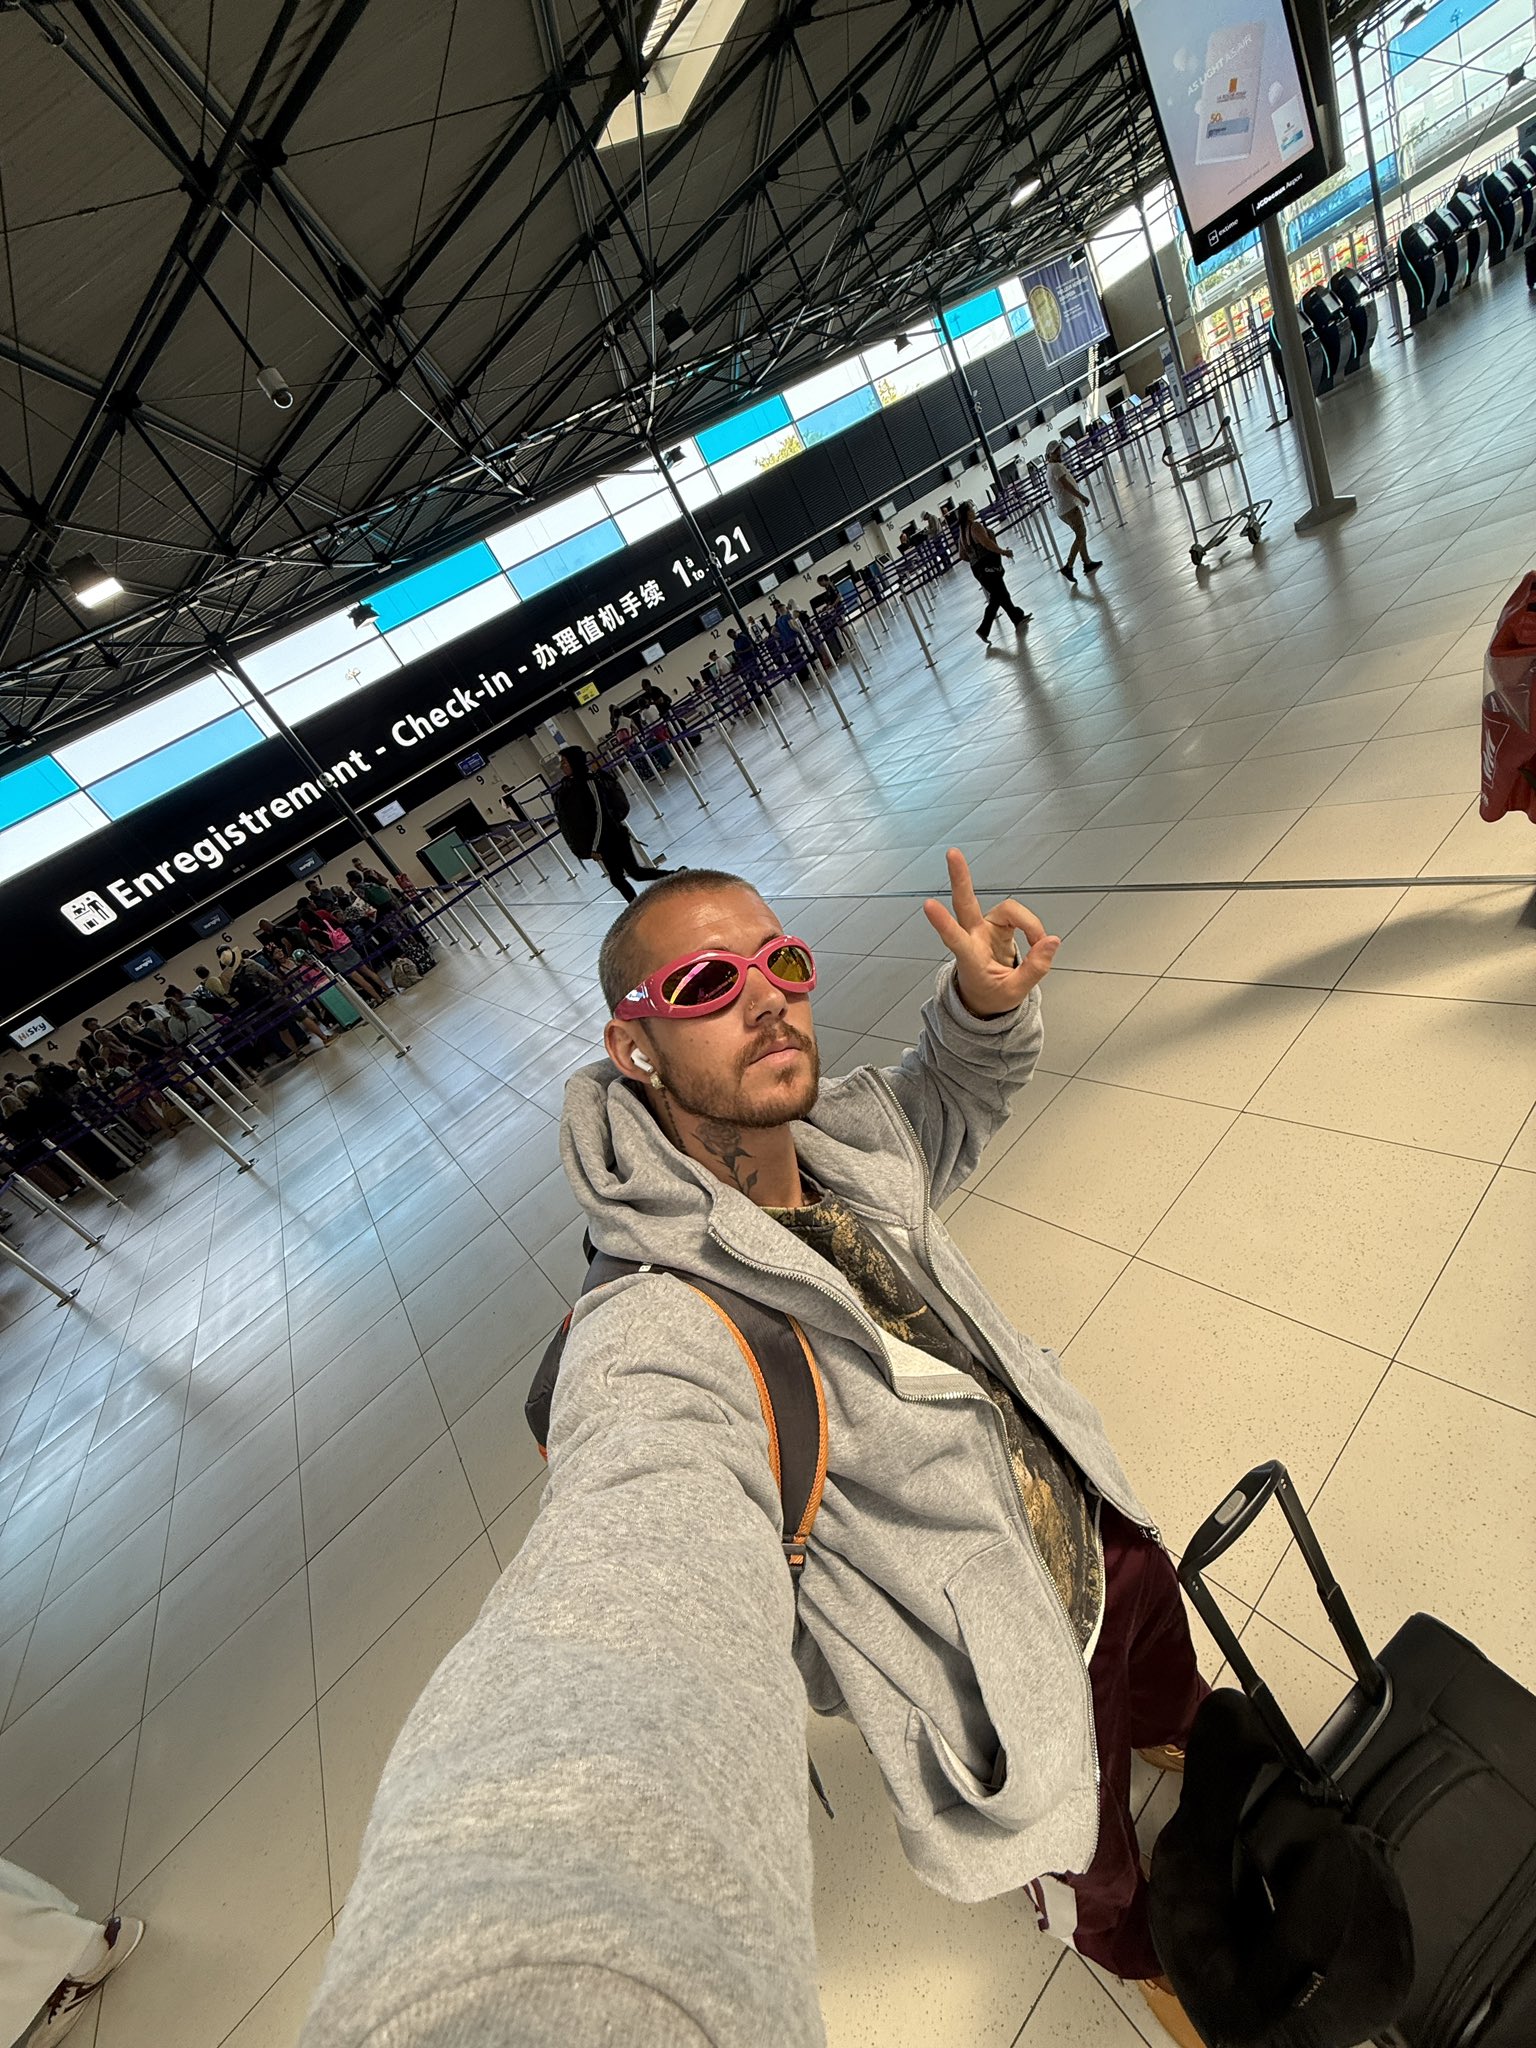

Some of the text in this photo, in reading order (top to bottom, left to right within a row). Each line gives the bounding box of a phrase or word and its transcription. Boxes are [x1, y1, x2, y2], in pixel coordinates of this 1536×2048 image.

[1188, 80, 1199, 96] AS
[1199, 57, 1224, 86] LIGHT
[1256, 186, 1286, 210] JCDecaux
[1218, 219, 1239, 236] extime
[1046, 423, 1053, 432] 20
[886, 520, 895, 531] 16
[853, 541, 862, 552] 15
[803, 572, 812, 582] 14
[391, 671, 514, 747] Check-in
[531, 579, 666, 670] 办理值机手续
[672, 559, 692, 588] 1
[684, 555, 695, 569] à
[692, 569, 705, 581] to
[715, 525, 751, 565] 21
[710, 629, 721, 640] 12
[653, 664, 664, 675] 11
[588, 703, 600, 715] 10
[476, 775, 485, 786] 9
[396, 824, 406, 835] 8
[313, 874, 323, 886] 7
[221, 932, 233, 943] 6
[153, 973, 166, 985] 5
[18, 1022, 47, 1041] HiSky
[47, 1040, 59, 1051] 4
